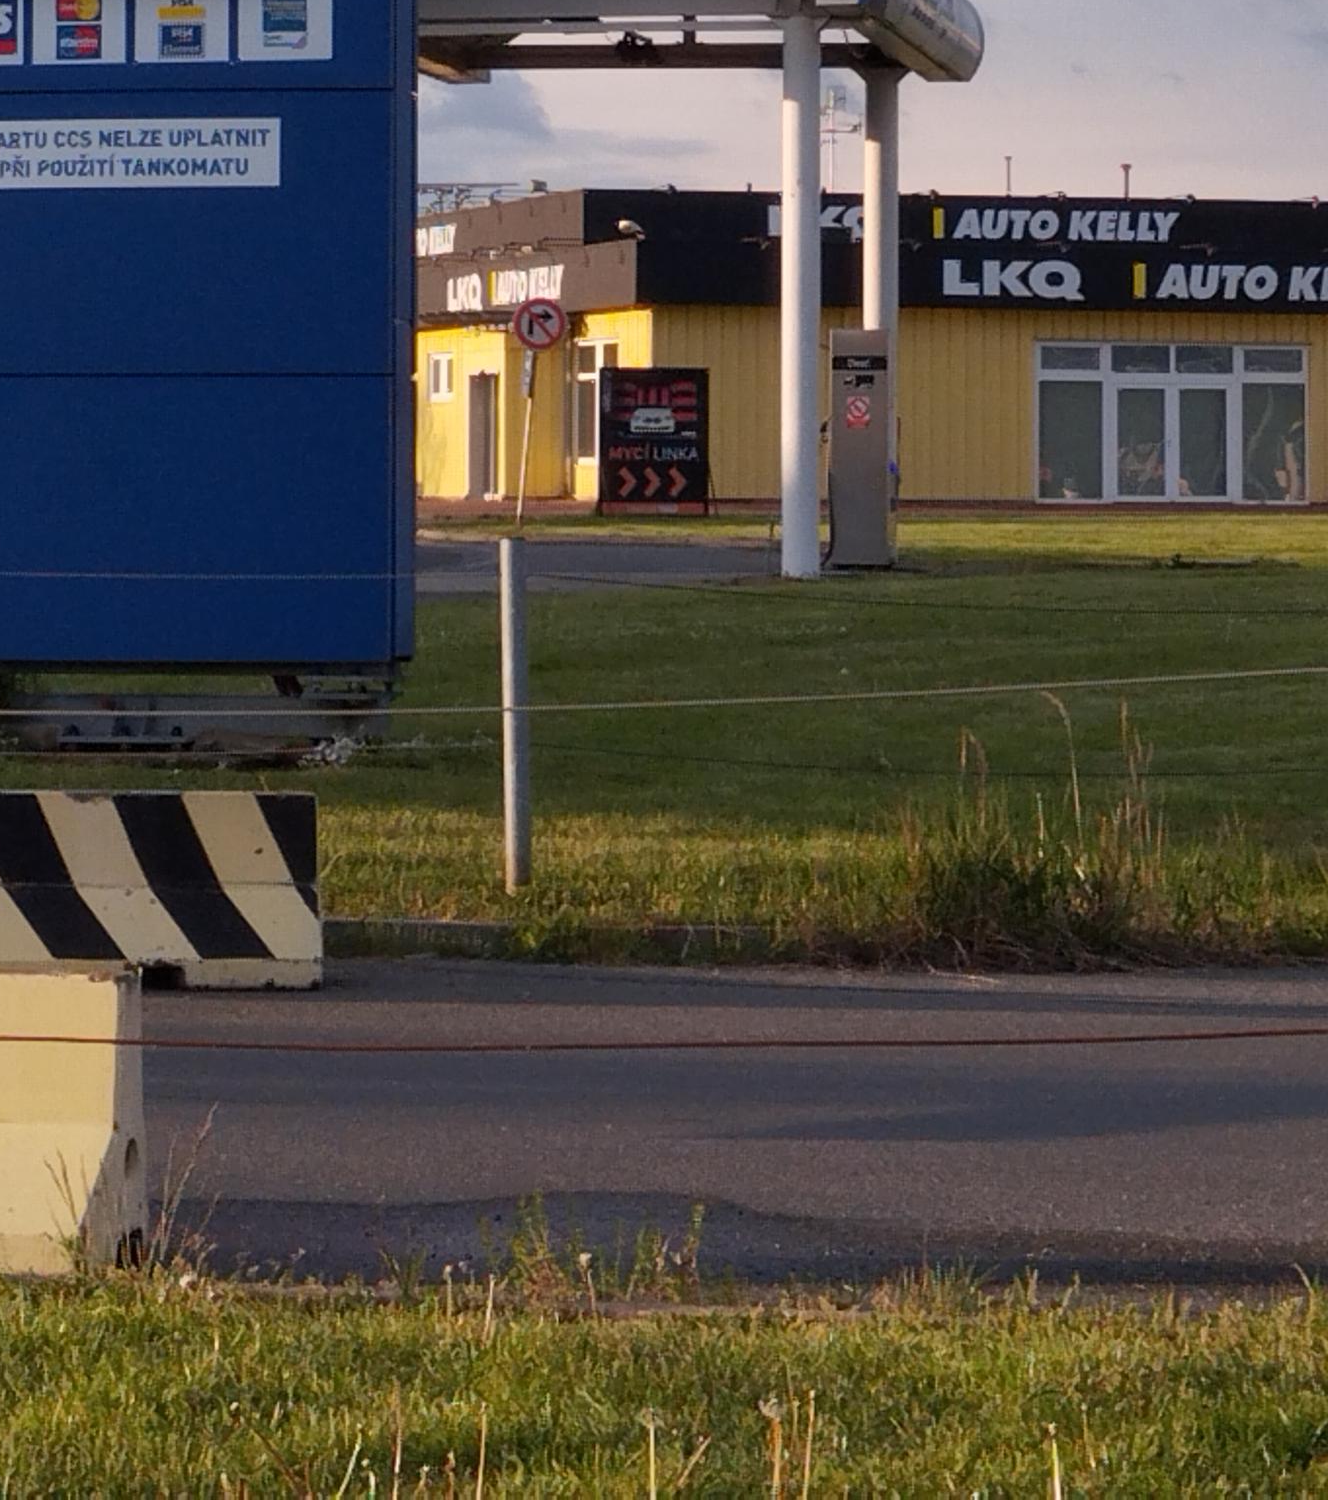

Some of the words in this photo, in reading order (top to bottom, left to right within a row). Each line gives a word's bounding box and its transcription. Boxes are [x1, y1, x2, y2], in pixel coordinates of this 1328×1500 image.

[53, 129, 93, 148] CCS
[98, 129, 163, 148] NELZE
[169, 128, 271, 148] UPLATNIT
[37, 154, 116, 177] POUŽITÍ
[121, 157, 250, 177] TANKOMATU
[953, 209, 1060, 241] AUTO
[1068, 209, 1180, 243] KELLY
[447, 273, 483, 312] LKQ
[942, 258, 1086, 301] LKQ
[1156, 264, 1279, 300] AUTO
[653, 445, 700, 462] LINKA
